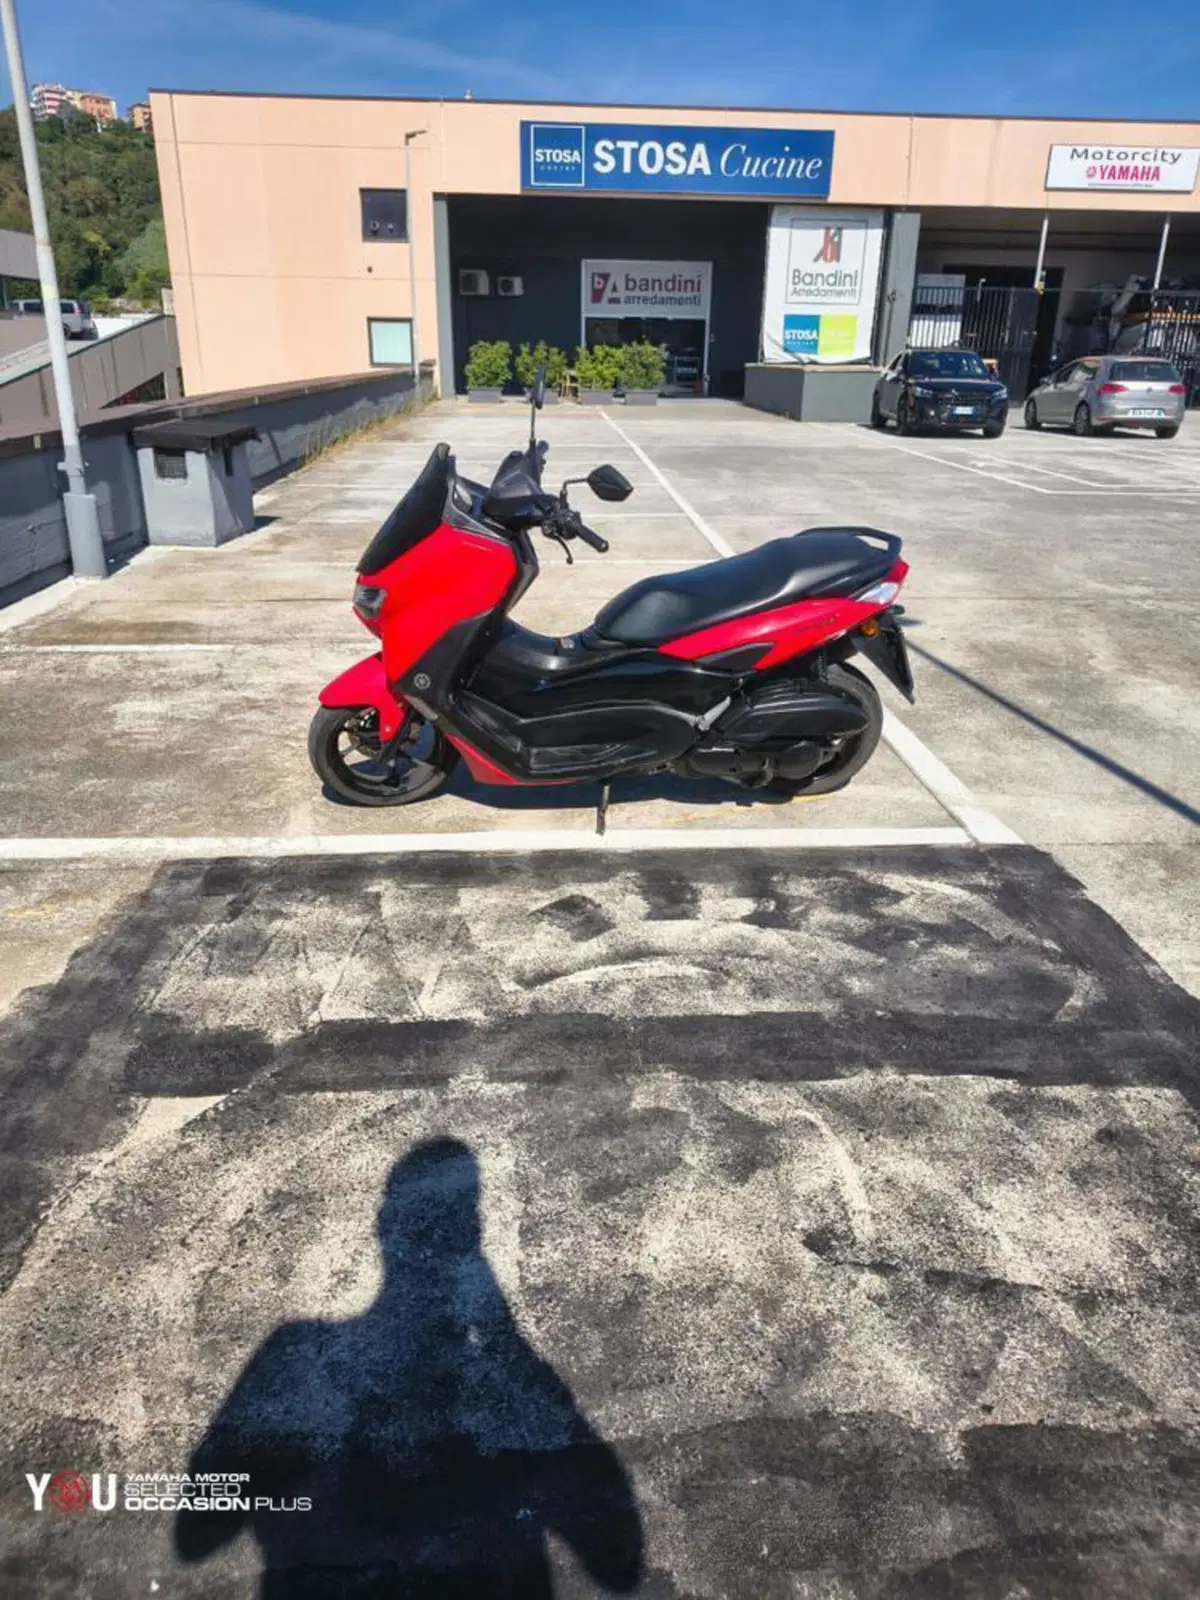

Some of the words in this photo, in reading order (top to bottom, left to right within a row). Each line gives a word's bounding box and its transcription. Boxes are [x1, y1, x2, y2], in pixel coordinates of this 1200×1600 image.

[535, 149, 581, 163] STOSA
[593, 140, 711, 176] STOSA
[720, 143, 822, 180] Cucine
[1070, 148, 1182, 165] Motorcity
[1099, 165, 1160, 181] YAMAHA
[624, 273, 702, 293] bandini
[792, 269, 858, 287] Bandini
[624, 294, 702, 306] arredamenti
[791, 287, 857, 298] Arredamenti
[784, 329, 818, 341] STOSA
